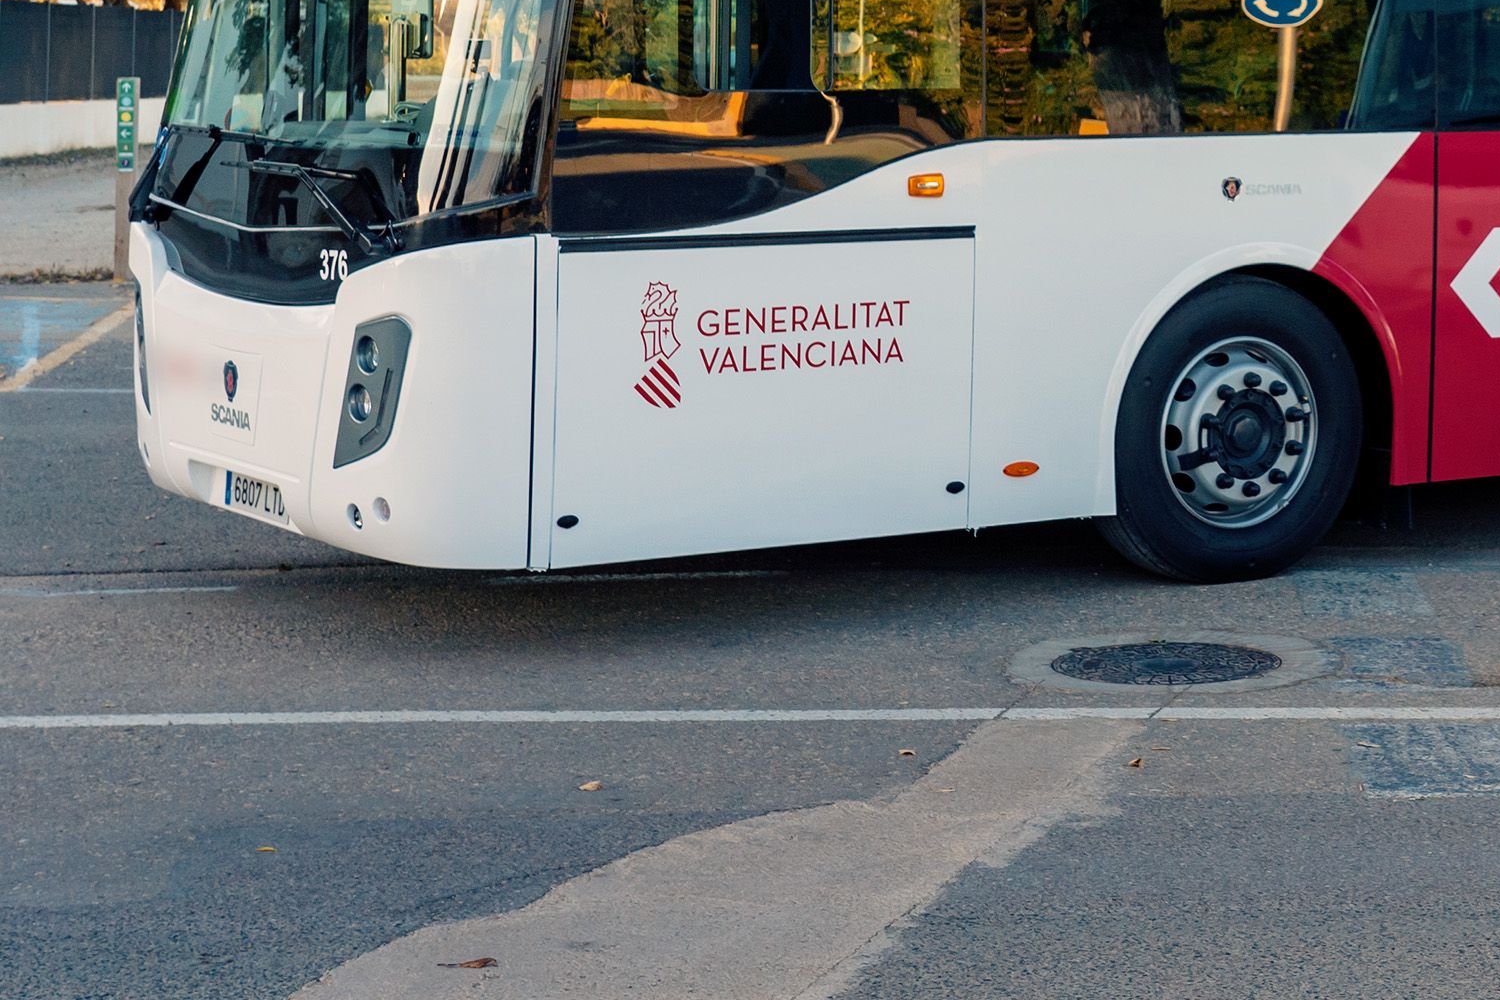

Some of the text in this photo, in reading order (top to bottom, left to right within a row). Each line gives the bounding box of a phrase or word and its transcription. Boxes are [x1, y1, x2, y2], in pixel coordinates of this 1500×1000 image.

[1245, 183, 1302, 196] SCANIA
[319, 248, 348, 280] 376
[696, 300, 911, 337] GENERALITAT
[699, 337, 904, 375] VALENCIANA
[211, 403, 251, 431] SCANIA
[234, 476, 263, 509] 6807
